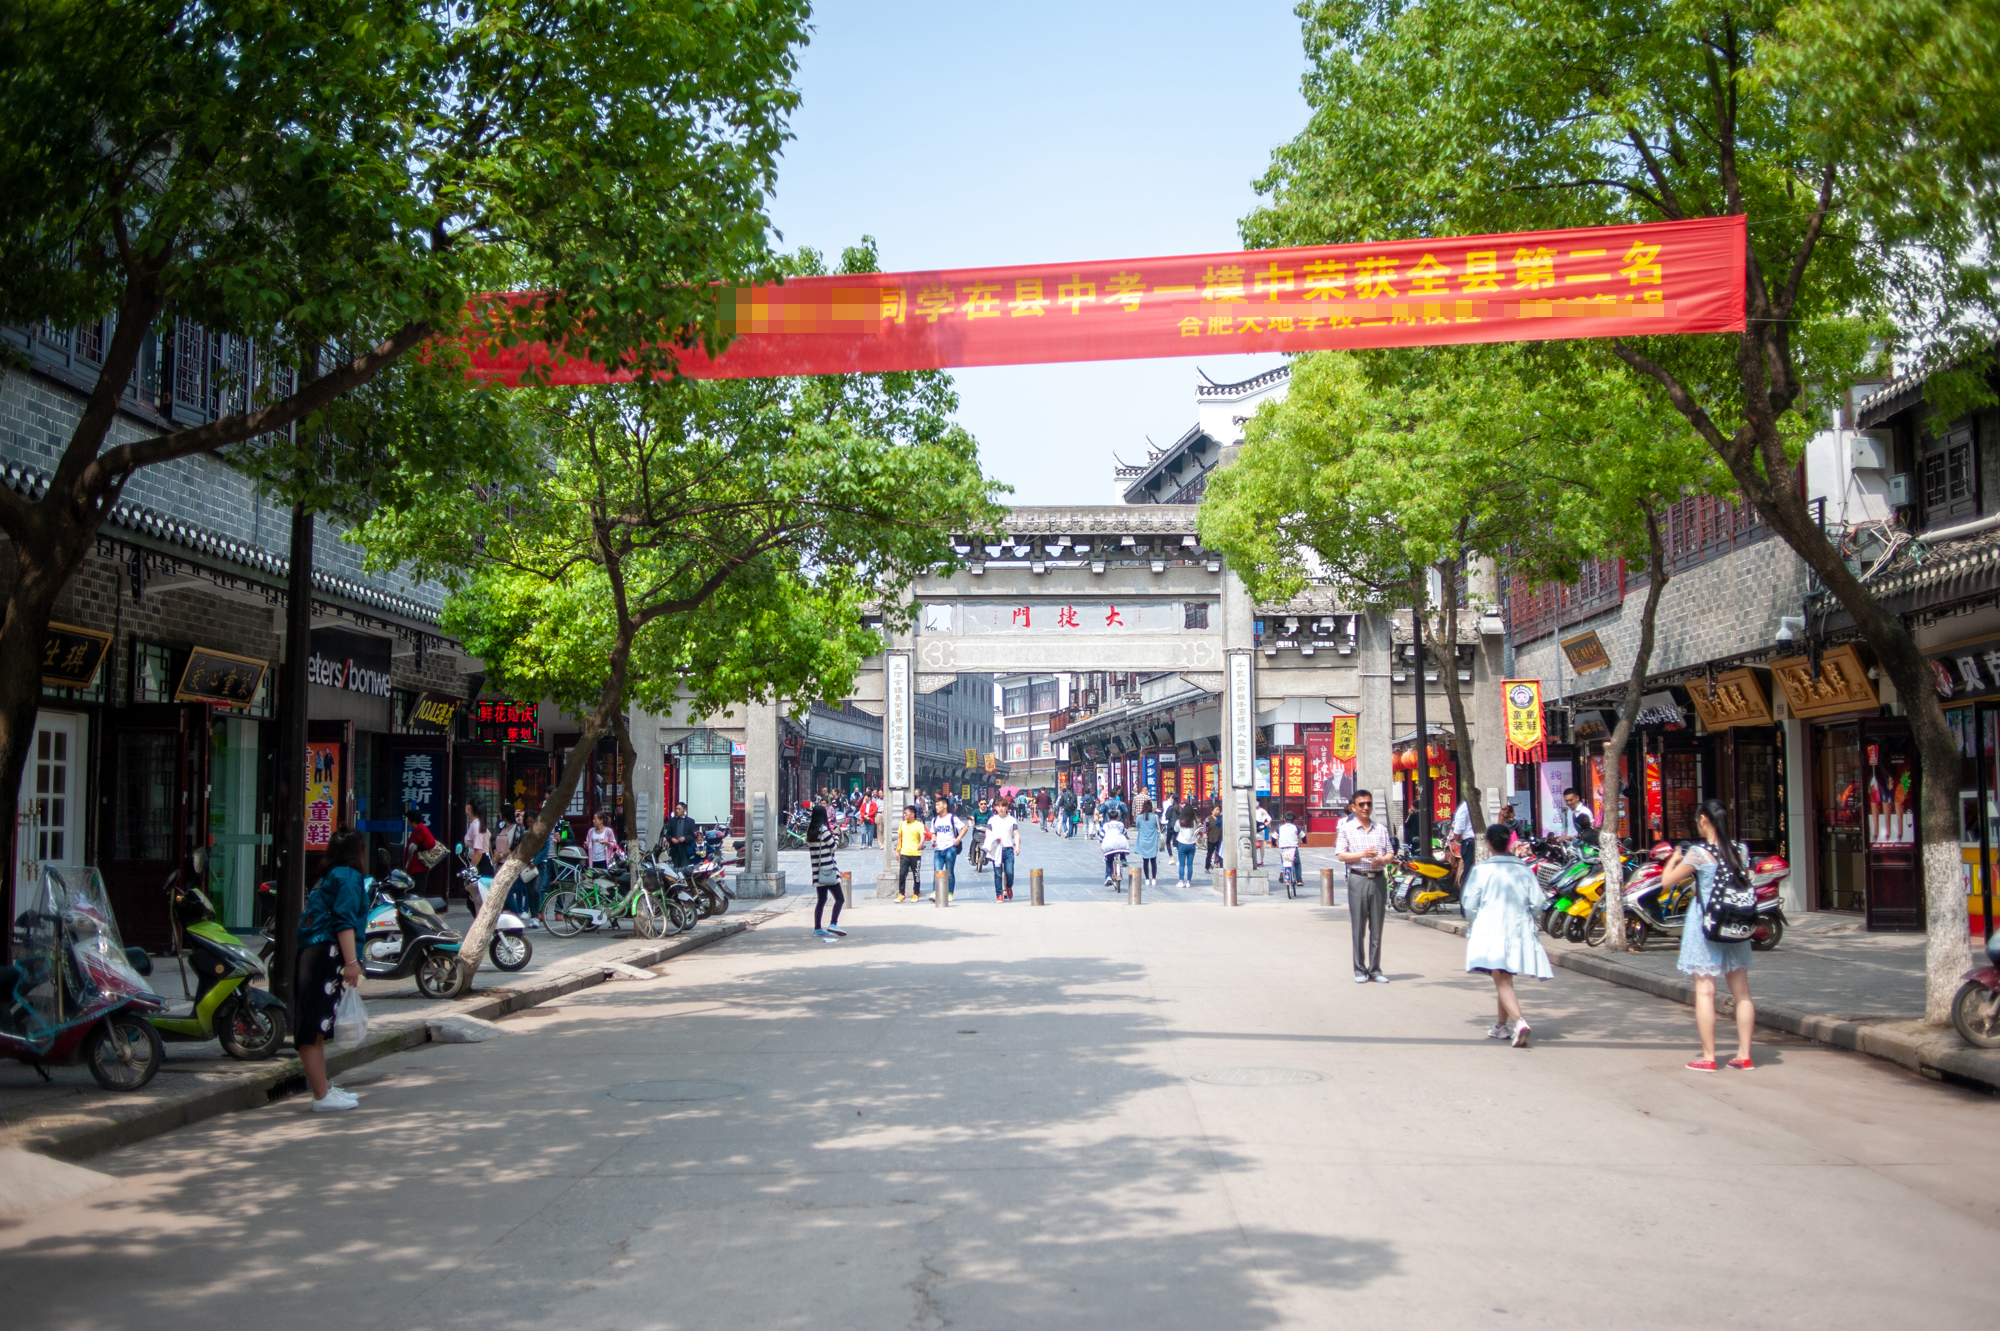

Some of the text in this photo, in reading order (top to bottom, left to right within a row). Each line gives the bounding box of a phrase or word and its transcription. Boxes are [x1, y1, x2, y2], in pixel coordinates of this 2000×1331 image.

[308, 652, 391, 698] eters/bonwe
[480, 705, 534, 723] 鲜花婚庆
[1163, 771, 1176, 798] 海信电
[1287, 757, 1303, 794] 格力空调
[1436, 764, 1454, 819] 春风酒楼
[1550, 769, 1564, 824] 纯琪饰品
[307, 800, 333, 844] 童鞋
